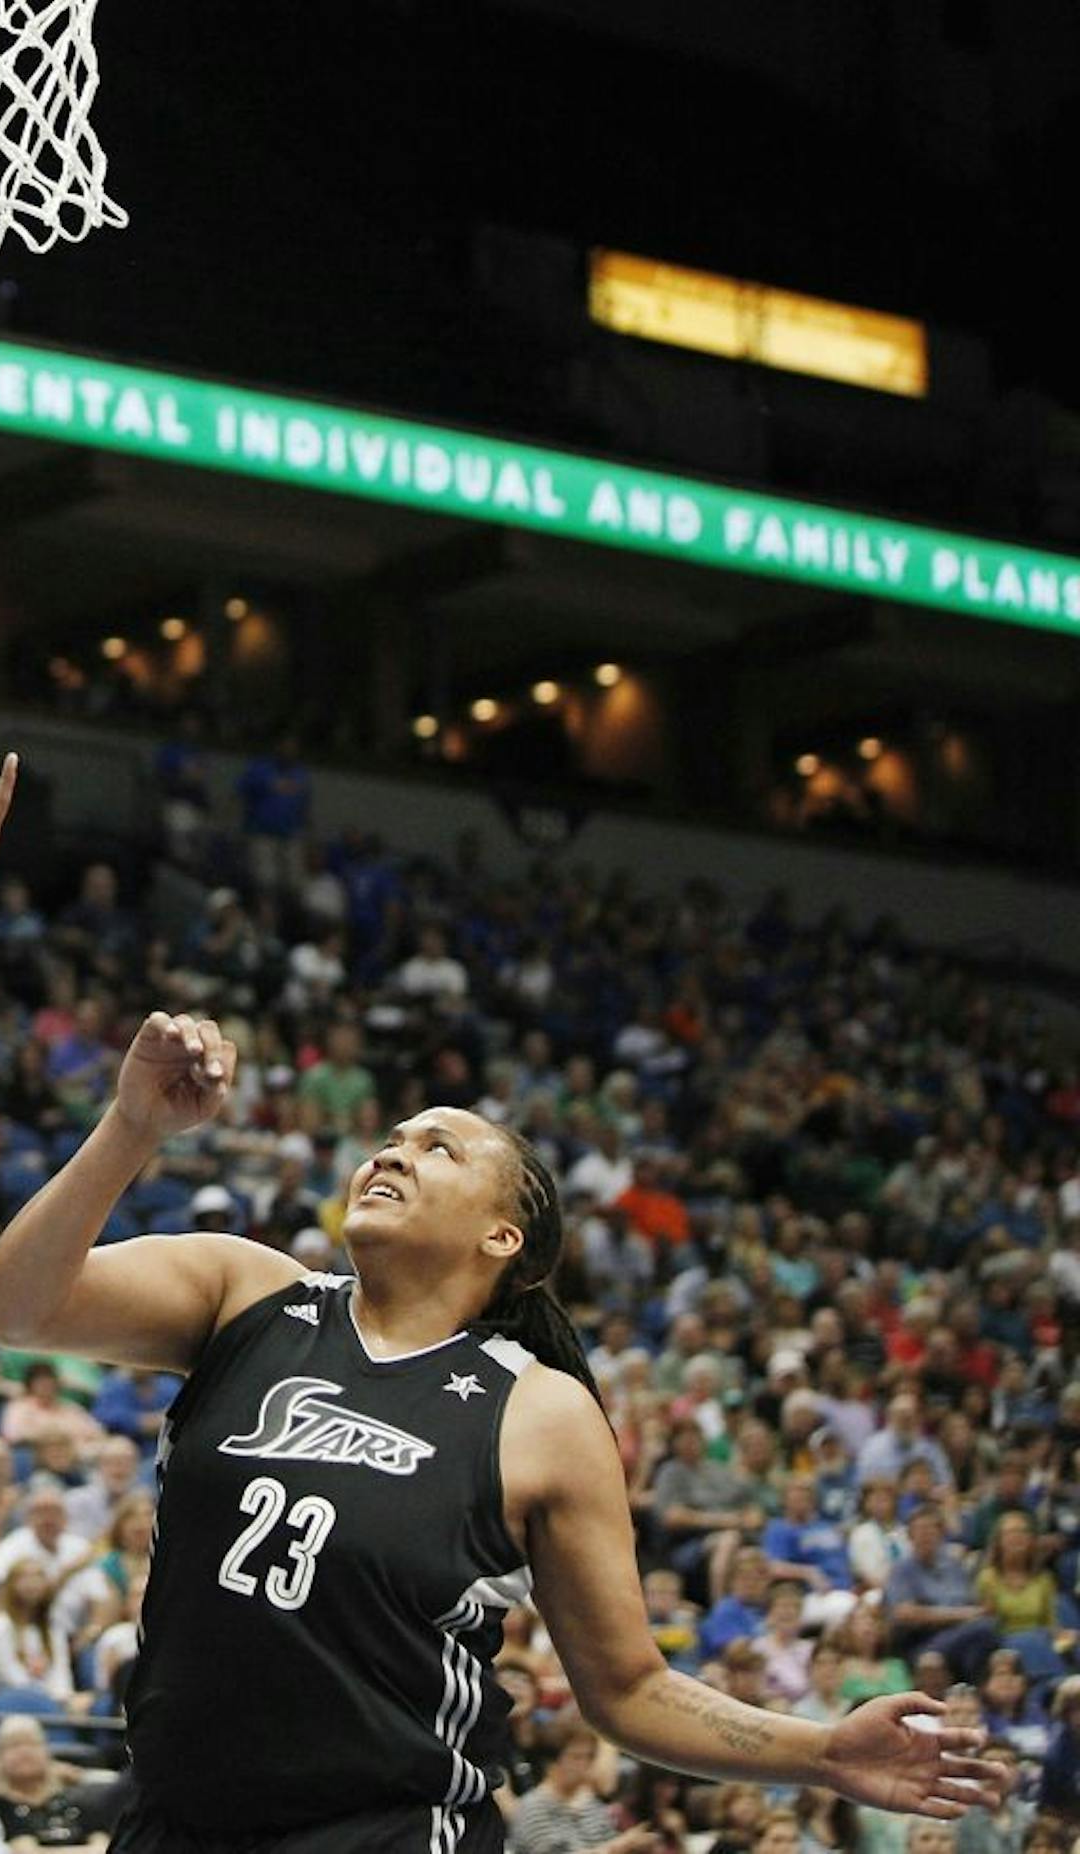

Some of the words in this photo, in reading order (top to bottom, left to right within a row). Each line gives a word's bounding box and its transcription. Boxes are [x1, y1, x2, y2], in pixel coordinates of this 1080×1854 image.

[217, 406, 567, 518] INDIVIDUAL
[587, 480, 703, 544] AND
[724, 507, 909, 584] FAMILY
[931, 547, 1080, 621] PLANS
[219, 1477, 336, 1610] 23
